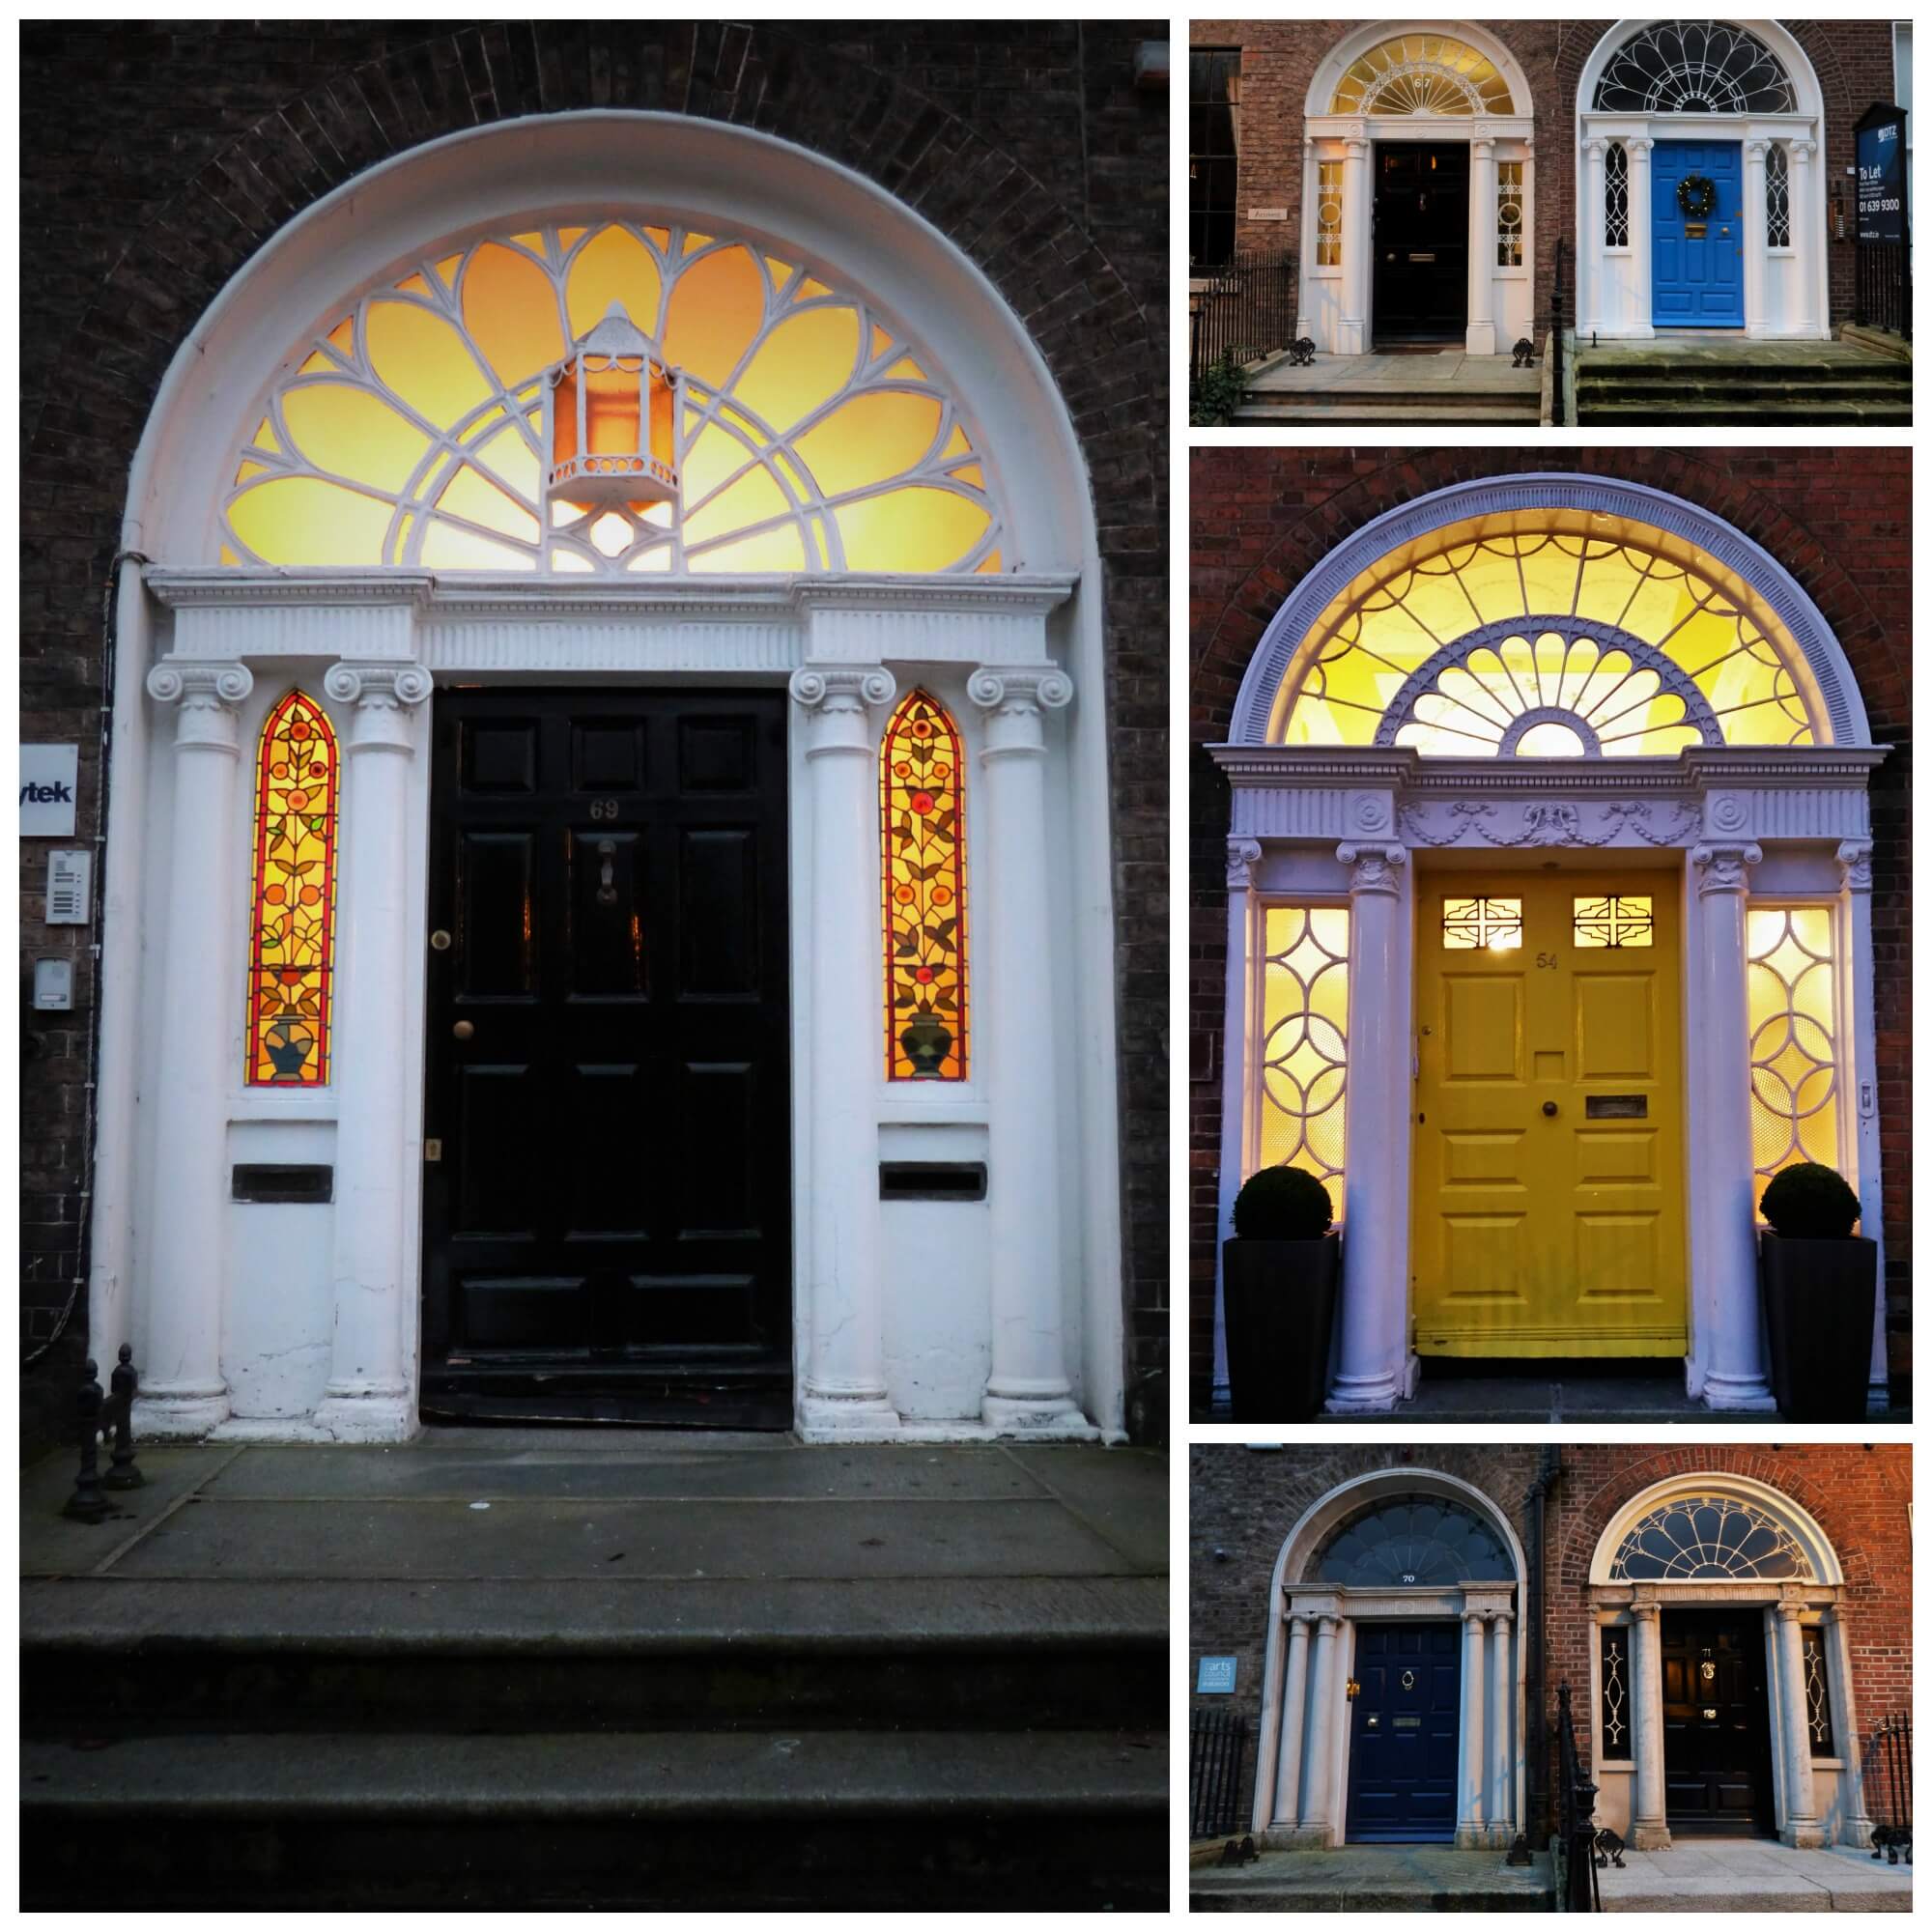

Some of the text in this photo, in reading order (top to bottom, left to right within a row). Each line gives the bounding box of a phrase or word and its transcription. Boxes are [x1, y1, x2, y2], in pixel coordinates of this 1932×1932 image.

[1414, 78, 1431, 88] 67
[1884, 125, 1897, 137] DTZ
[1859, 164, 1882, 181] To Let
[1859, 198, 1900, 213] 01 639 9300
[590, 798, 619, 820] 69
[1536, 952, 1557, 970] 54
[1402, 1575, 1415, 1583] 70
[1701, 1648, 1711, 1658] 71
[1210, 1662, 1231, 1671] arts
